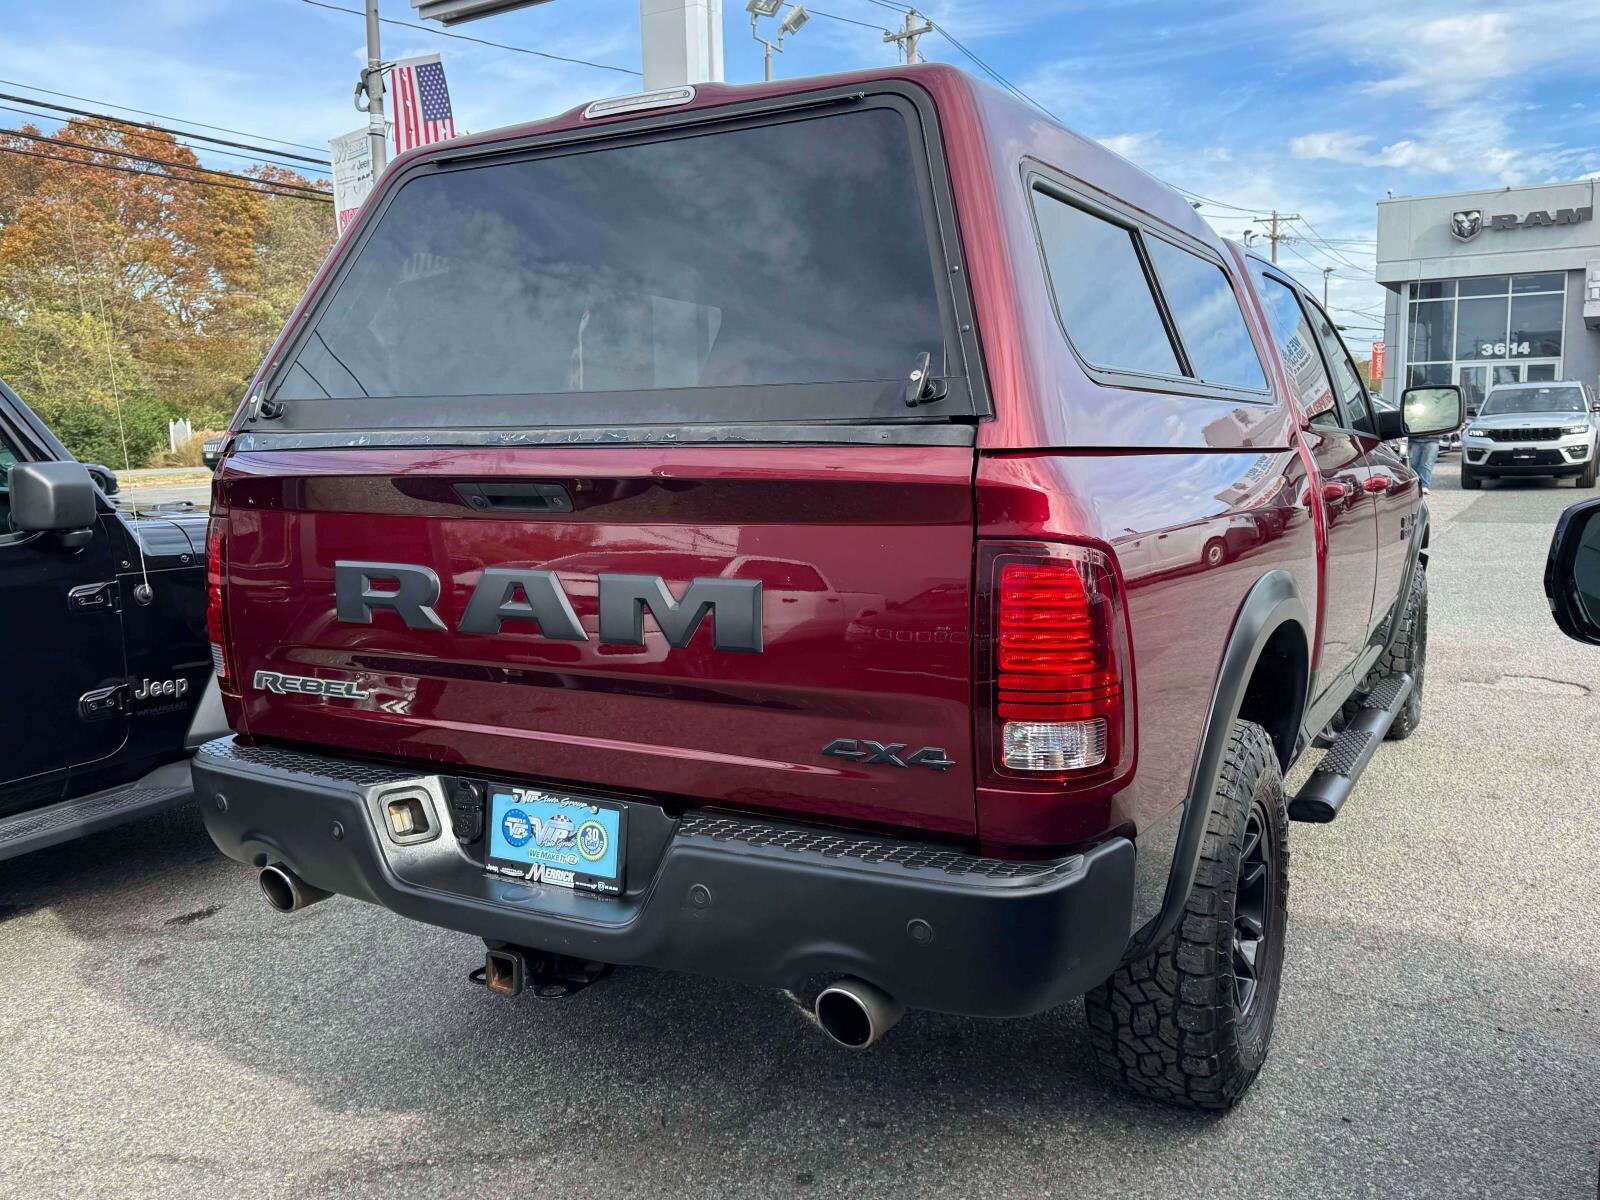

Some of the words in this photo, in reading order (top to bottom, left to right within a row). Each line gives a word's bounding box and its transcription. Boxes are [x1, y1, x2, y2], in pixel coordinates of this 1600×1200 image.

[1491, 206, 1593, 231] RAM
[1481, 341, 1531, 356] 3614
[334, 559, 764, 653] RAM
[135, 678, 189, 700] Jeep
[253, 670, 371, 701] REBEL
[560, 797, 588, 809] Group
[585, 827, 599, 842] 30
[529, 848, 541, 858] WE
[541, 851, 560, 862] MAKE
[525, 862, 576, 884] MERRICK
